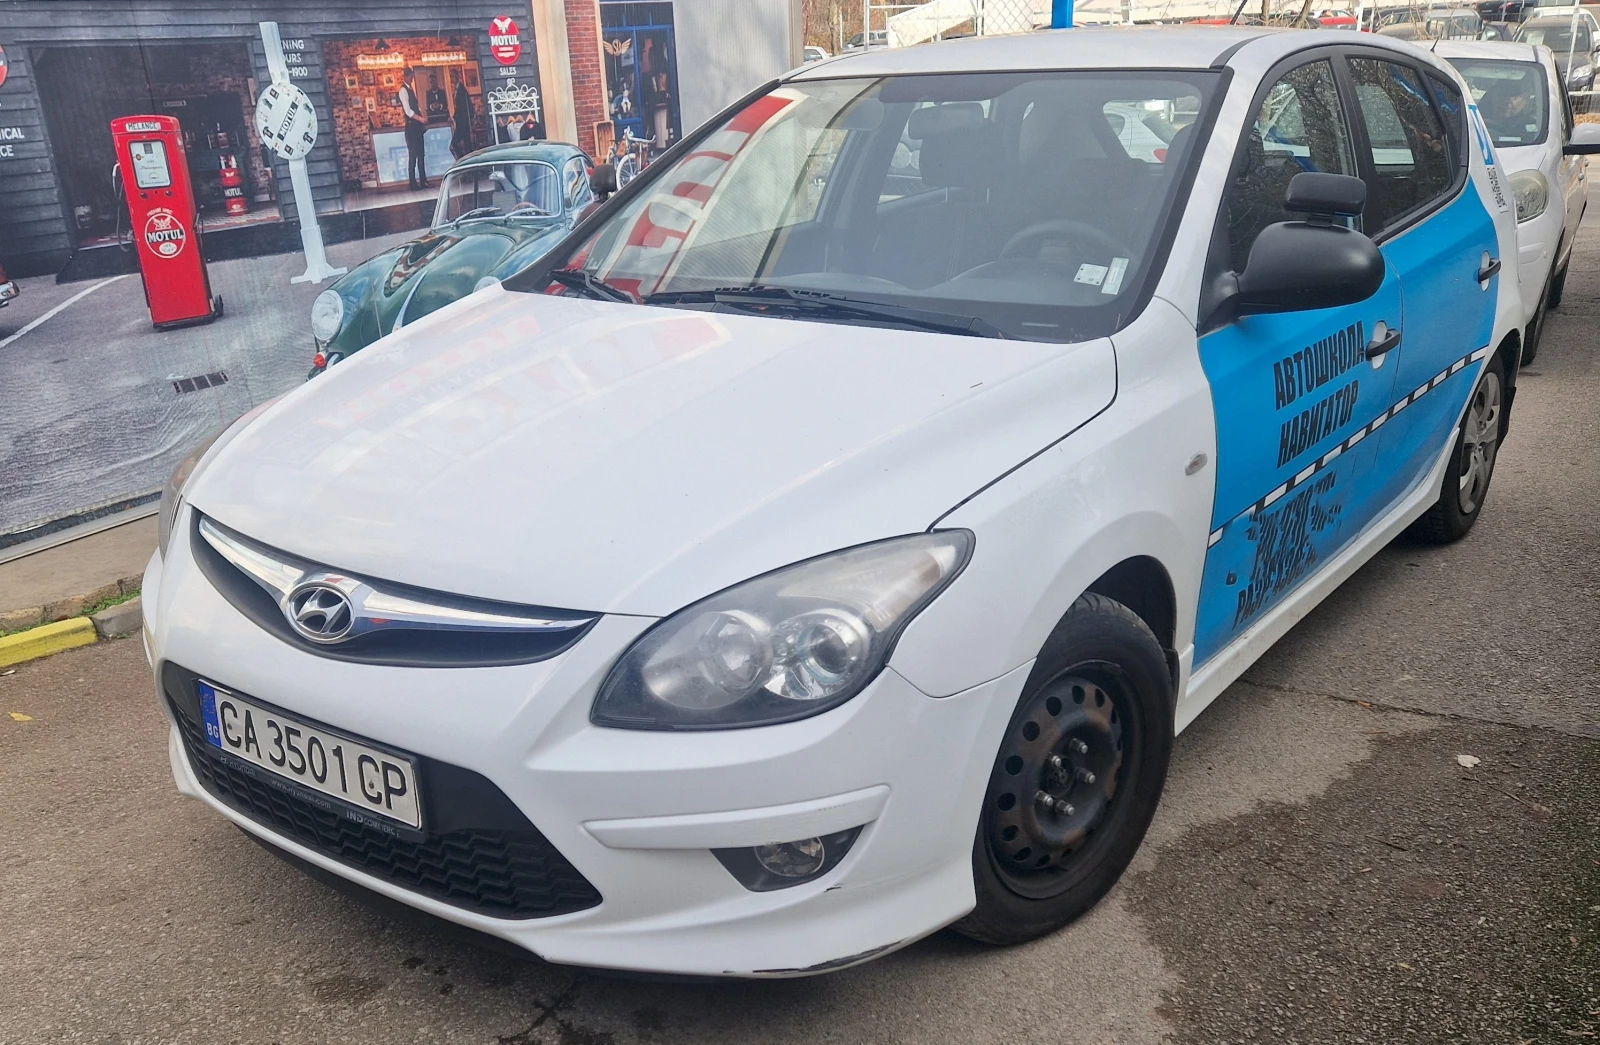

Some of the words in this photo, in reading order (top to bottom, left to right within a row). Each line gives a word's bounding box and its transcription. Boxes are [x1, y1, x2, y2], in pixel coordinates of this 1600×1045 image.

[282, 39, 305, 50] NING
[490, 34, 520, 46] MOTUL
[289, 66, 308, 77] -1900
[499, 66, 517, 76] SALES
[279, 106, 297, 137] MOTUL
[0, 144, 15, 157] CE
[147, 229, 184, 243] MOTUL
[1273, 320, 1365, 412] АВТОШКОЛА
[1276, 379, 1360, 470] НАВИГАТОР
[206, 722, 220, 739] BG
